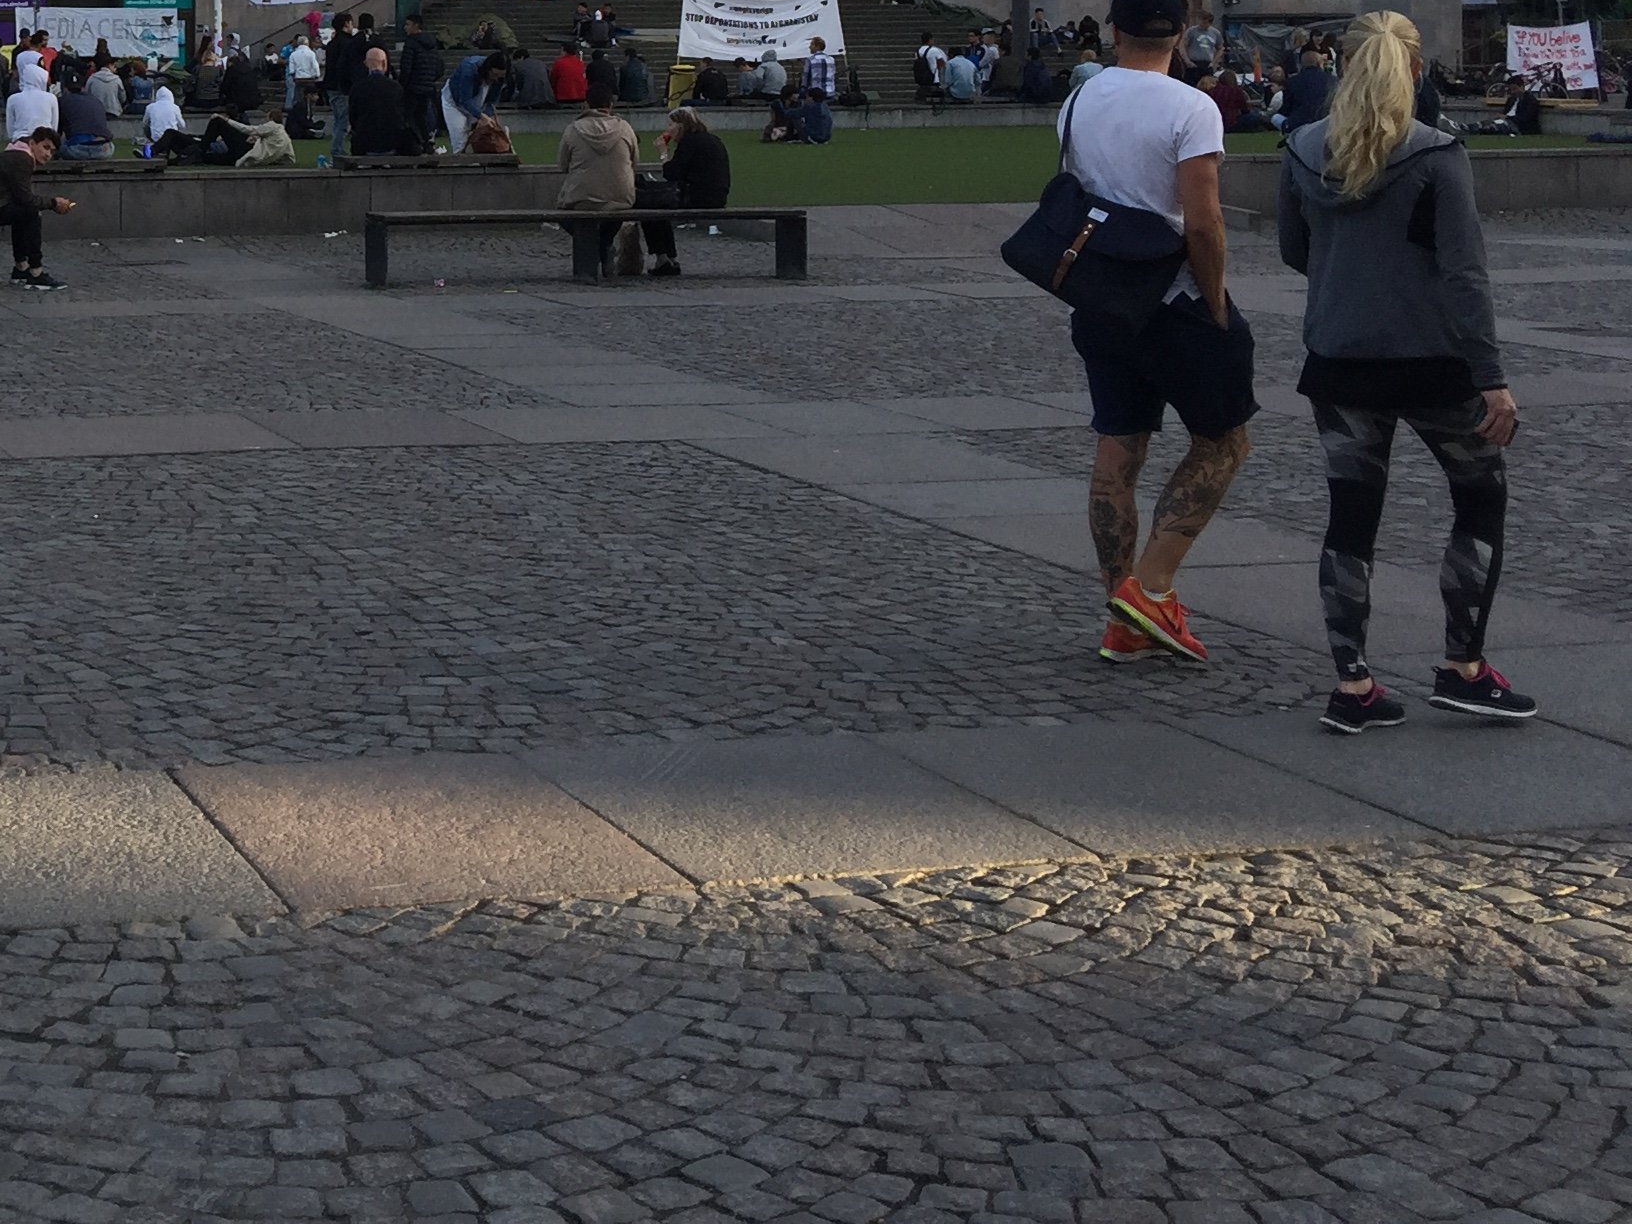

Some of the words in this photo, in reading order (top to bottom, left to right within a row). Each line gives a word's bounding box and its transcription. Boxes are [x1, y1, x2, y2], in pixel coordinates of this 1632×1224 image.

[685, 13, 703, 23] STOP
[705, 15, 759, 29] DEPORTATIONS
[759, 21, 770, 29] TO
[770, 13, 819, 28] AFGHANISTAN
[1528, 31, 1547, 46] YOU
